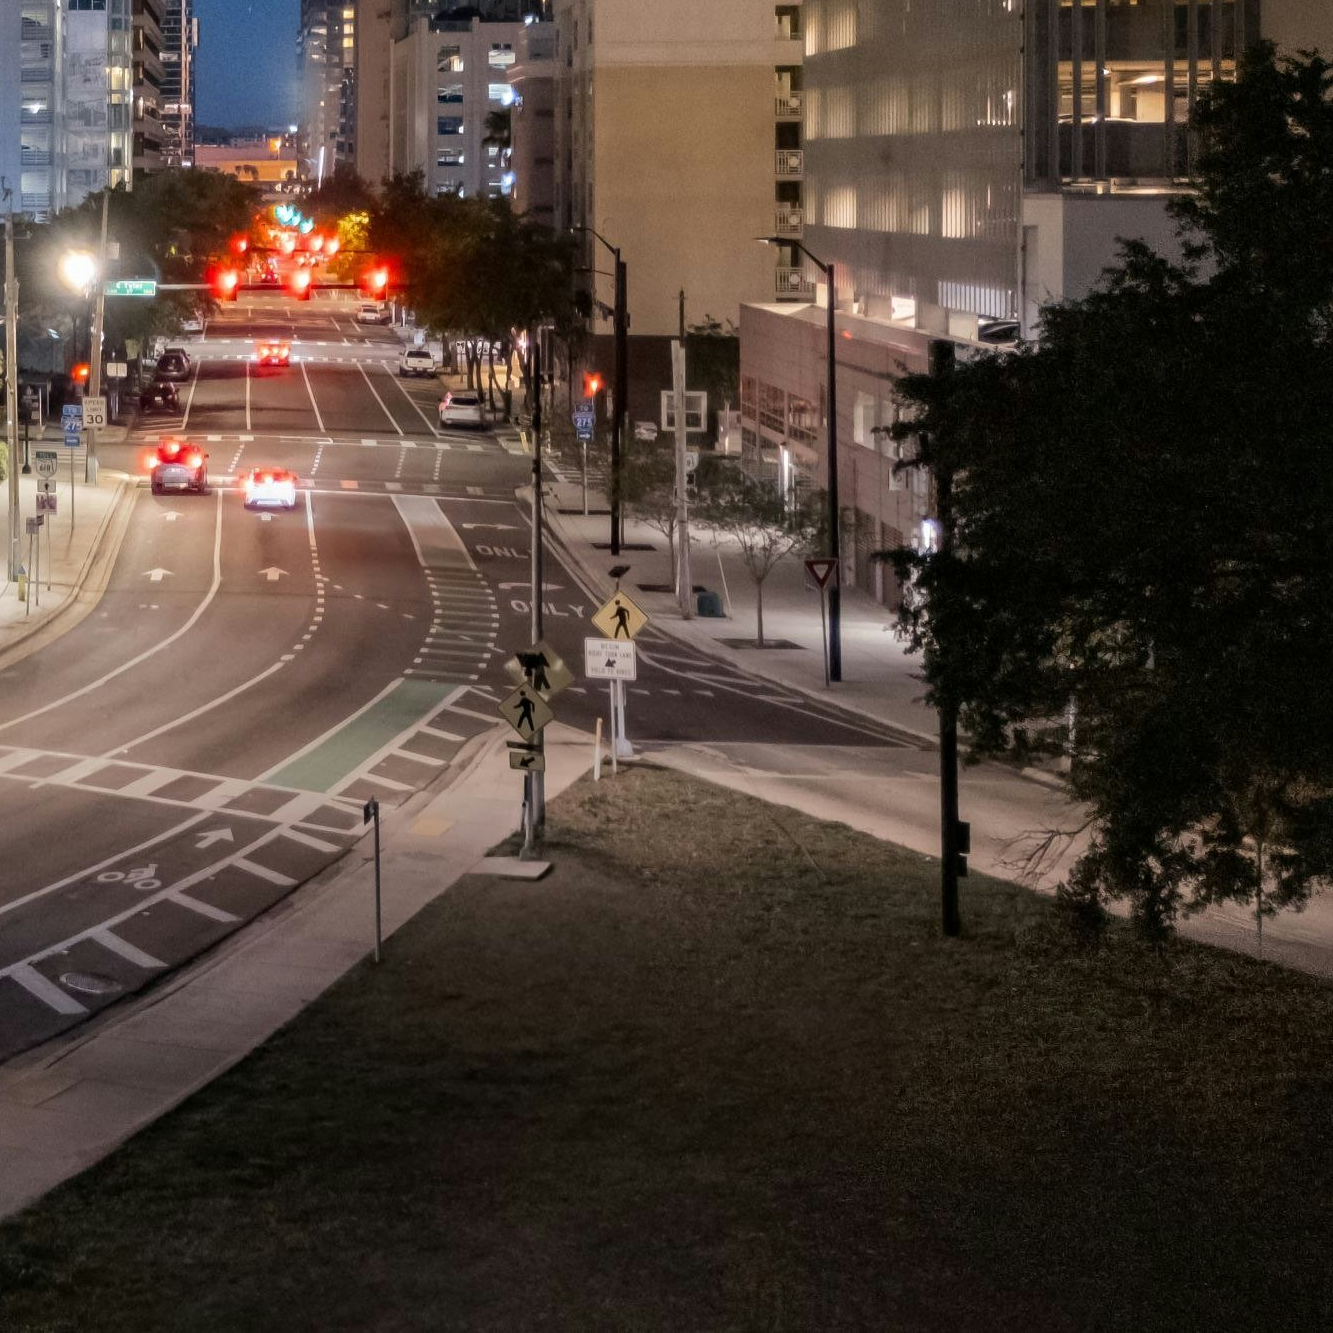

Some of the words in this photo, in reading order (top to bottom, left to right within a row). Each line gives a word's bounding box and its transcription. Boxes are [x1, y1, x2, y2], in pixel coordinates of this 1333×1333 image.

[64, 420, 82, 430] 275
[86, 414, 104, 425] 30
[576, 417, 592, 427] 275
[475, 545, 532, 559] ONL
[510, 599, 584, 618] ONLY
